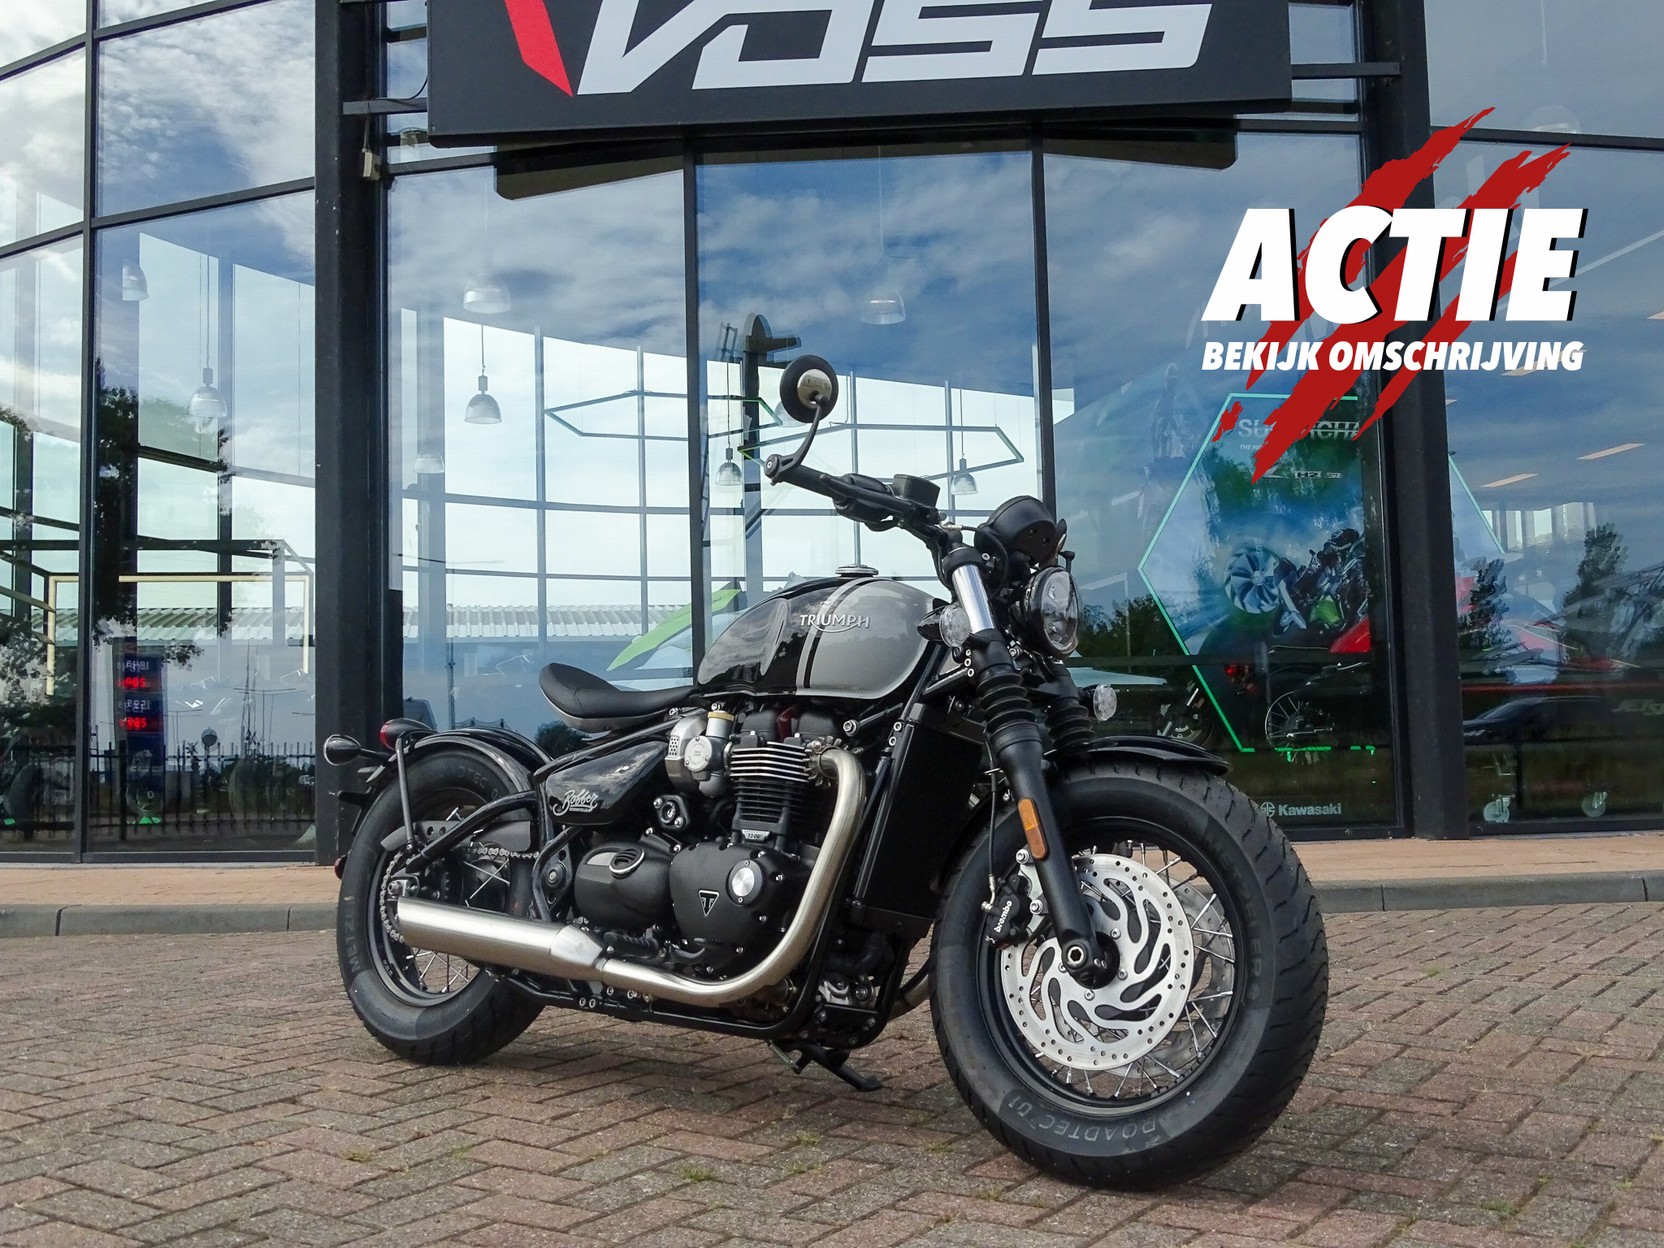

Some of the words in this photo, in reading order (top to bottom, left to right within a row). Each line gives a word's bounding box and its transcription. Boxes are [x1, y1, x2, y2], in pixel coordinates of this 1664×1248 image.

[800, 613, 870, 633] TRIUMPH
[553, 789, 598, 816] Bobber
[1278, 803, 1342, 816] Kawasaki
[994, 901, 1012, 933] brembo
[1038, 1116, 1157, 1142] ROADTEC
